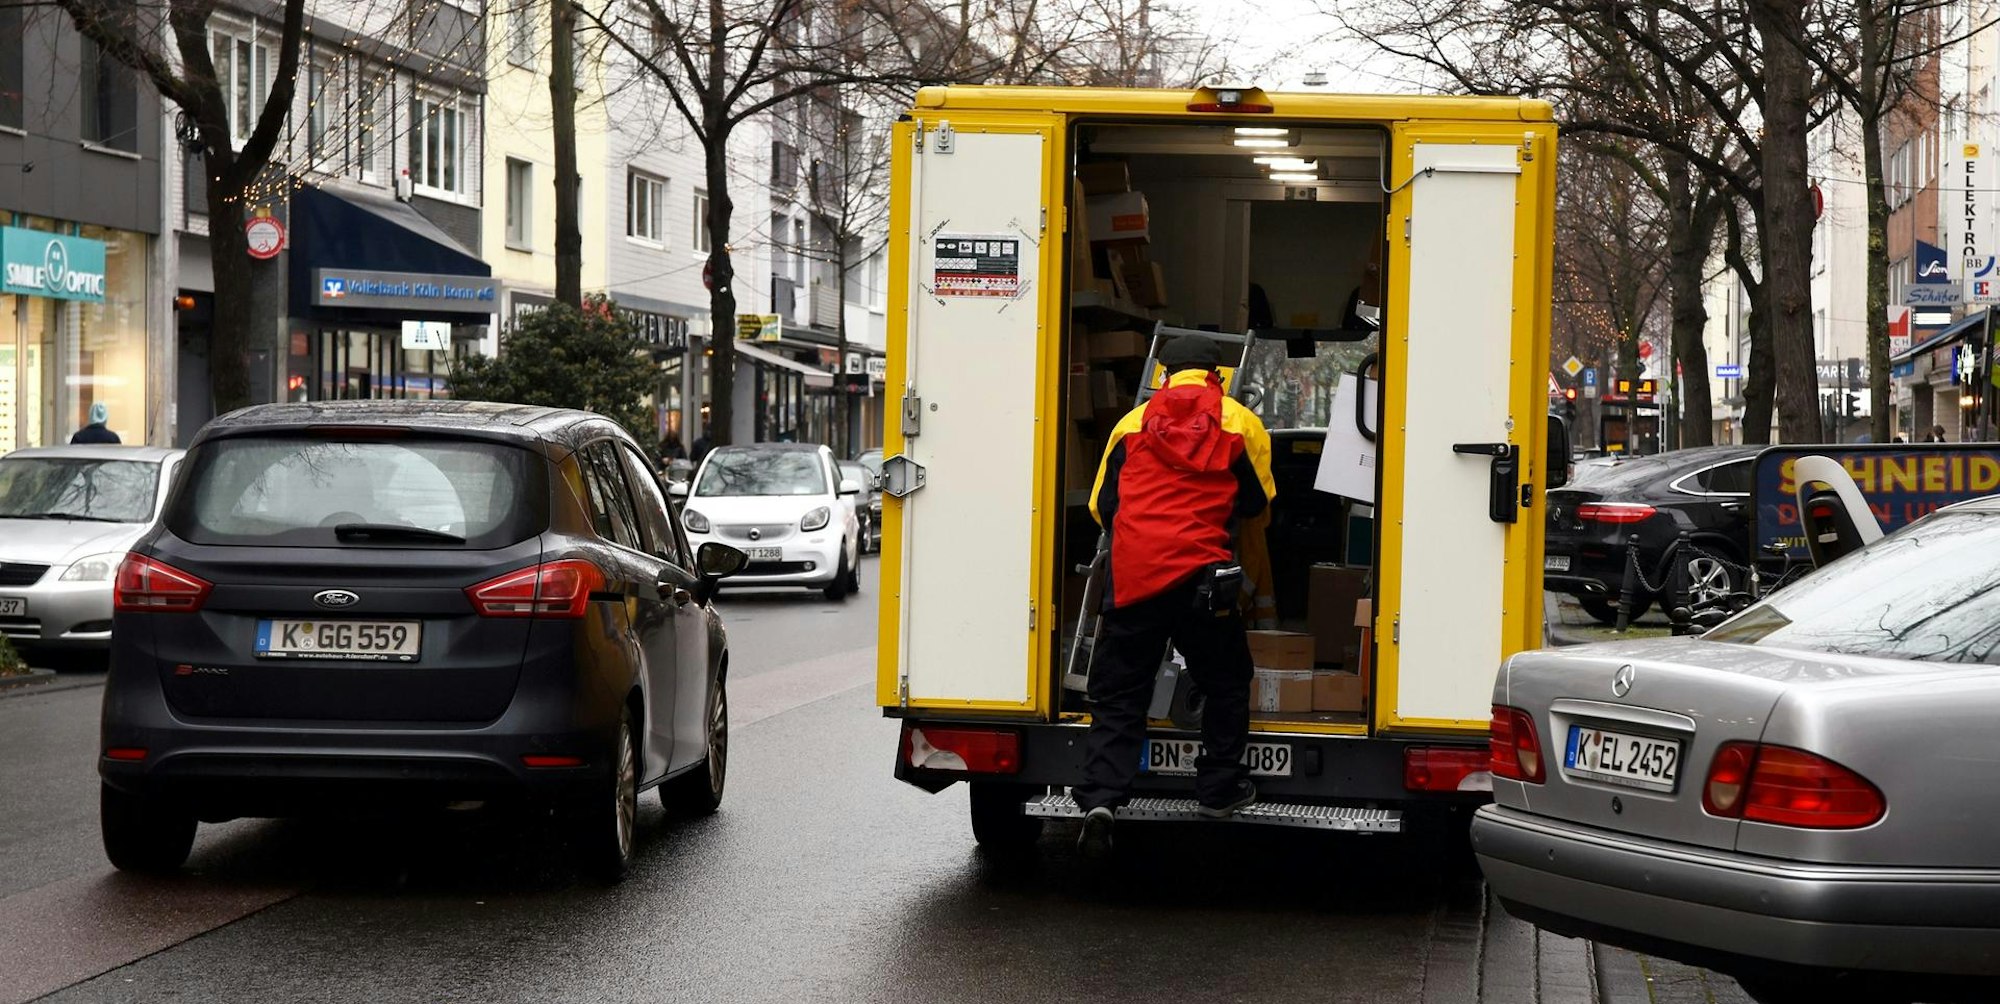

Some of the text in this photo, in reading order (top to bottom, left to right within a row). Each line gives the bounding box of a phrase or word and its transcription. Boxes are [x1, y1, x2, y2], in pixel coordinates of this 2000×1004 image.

[6, 263, 104, 296] SMILE OPTIC
[347, 279, 409, 295] Volksbank
[412, 283, 440, 297] Köln
[444, 285, 474, 299] Bonn
[1779, 457, 2000, 493] SHNEID
[324, 593, 349, 604] Ford
[282, 624, 298, 648] K
[318, 624, 352, 649] GG
[358, 625, 408, 650] 559
[1151, 743, 1180, 767] BN
[1578, 732, 1592, 765] K
[1600, 736, 1623, 771] EL
[1627, 741, 1676, 780] 2452
